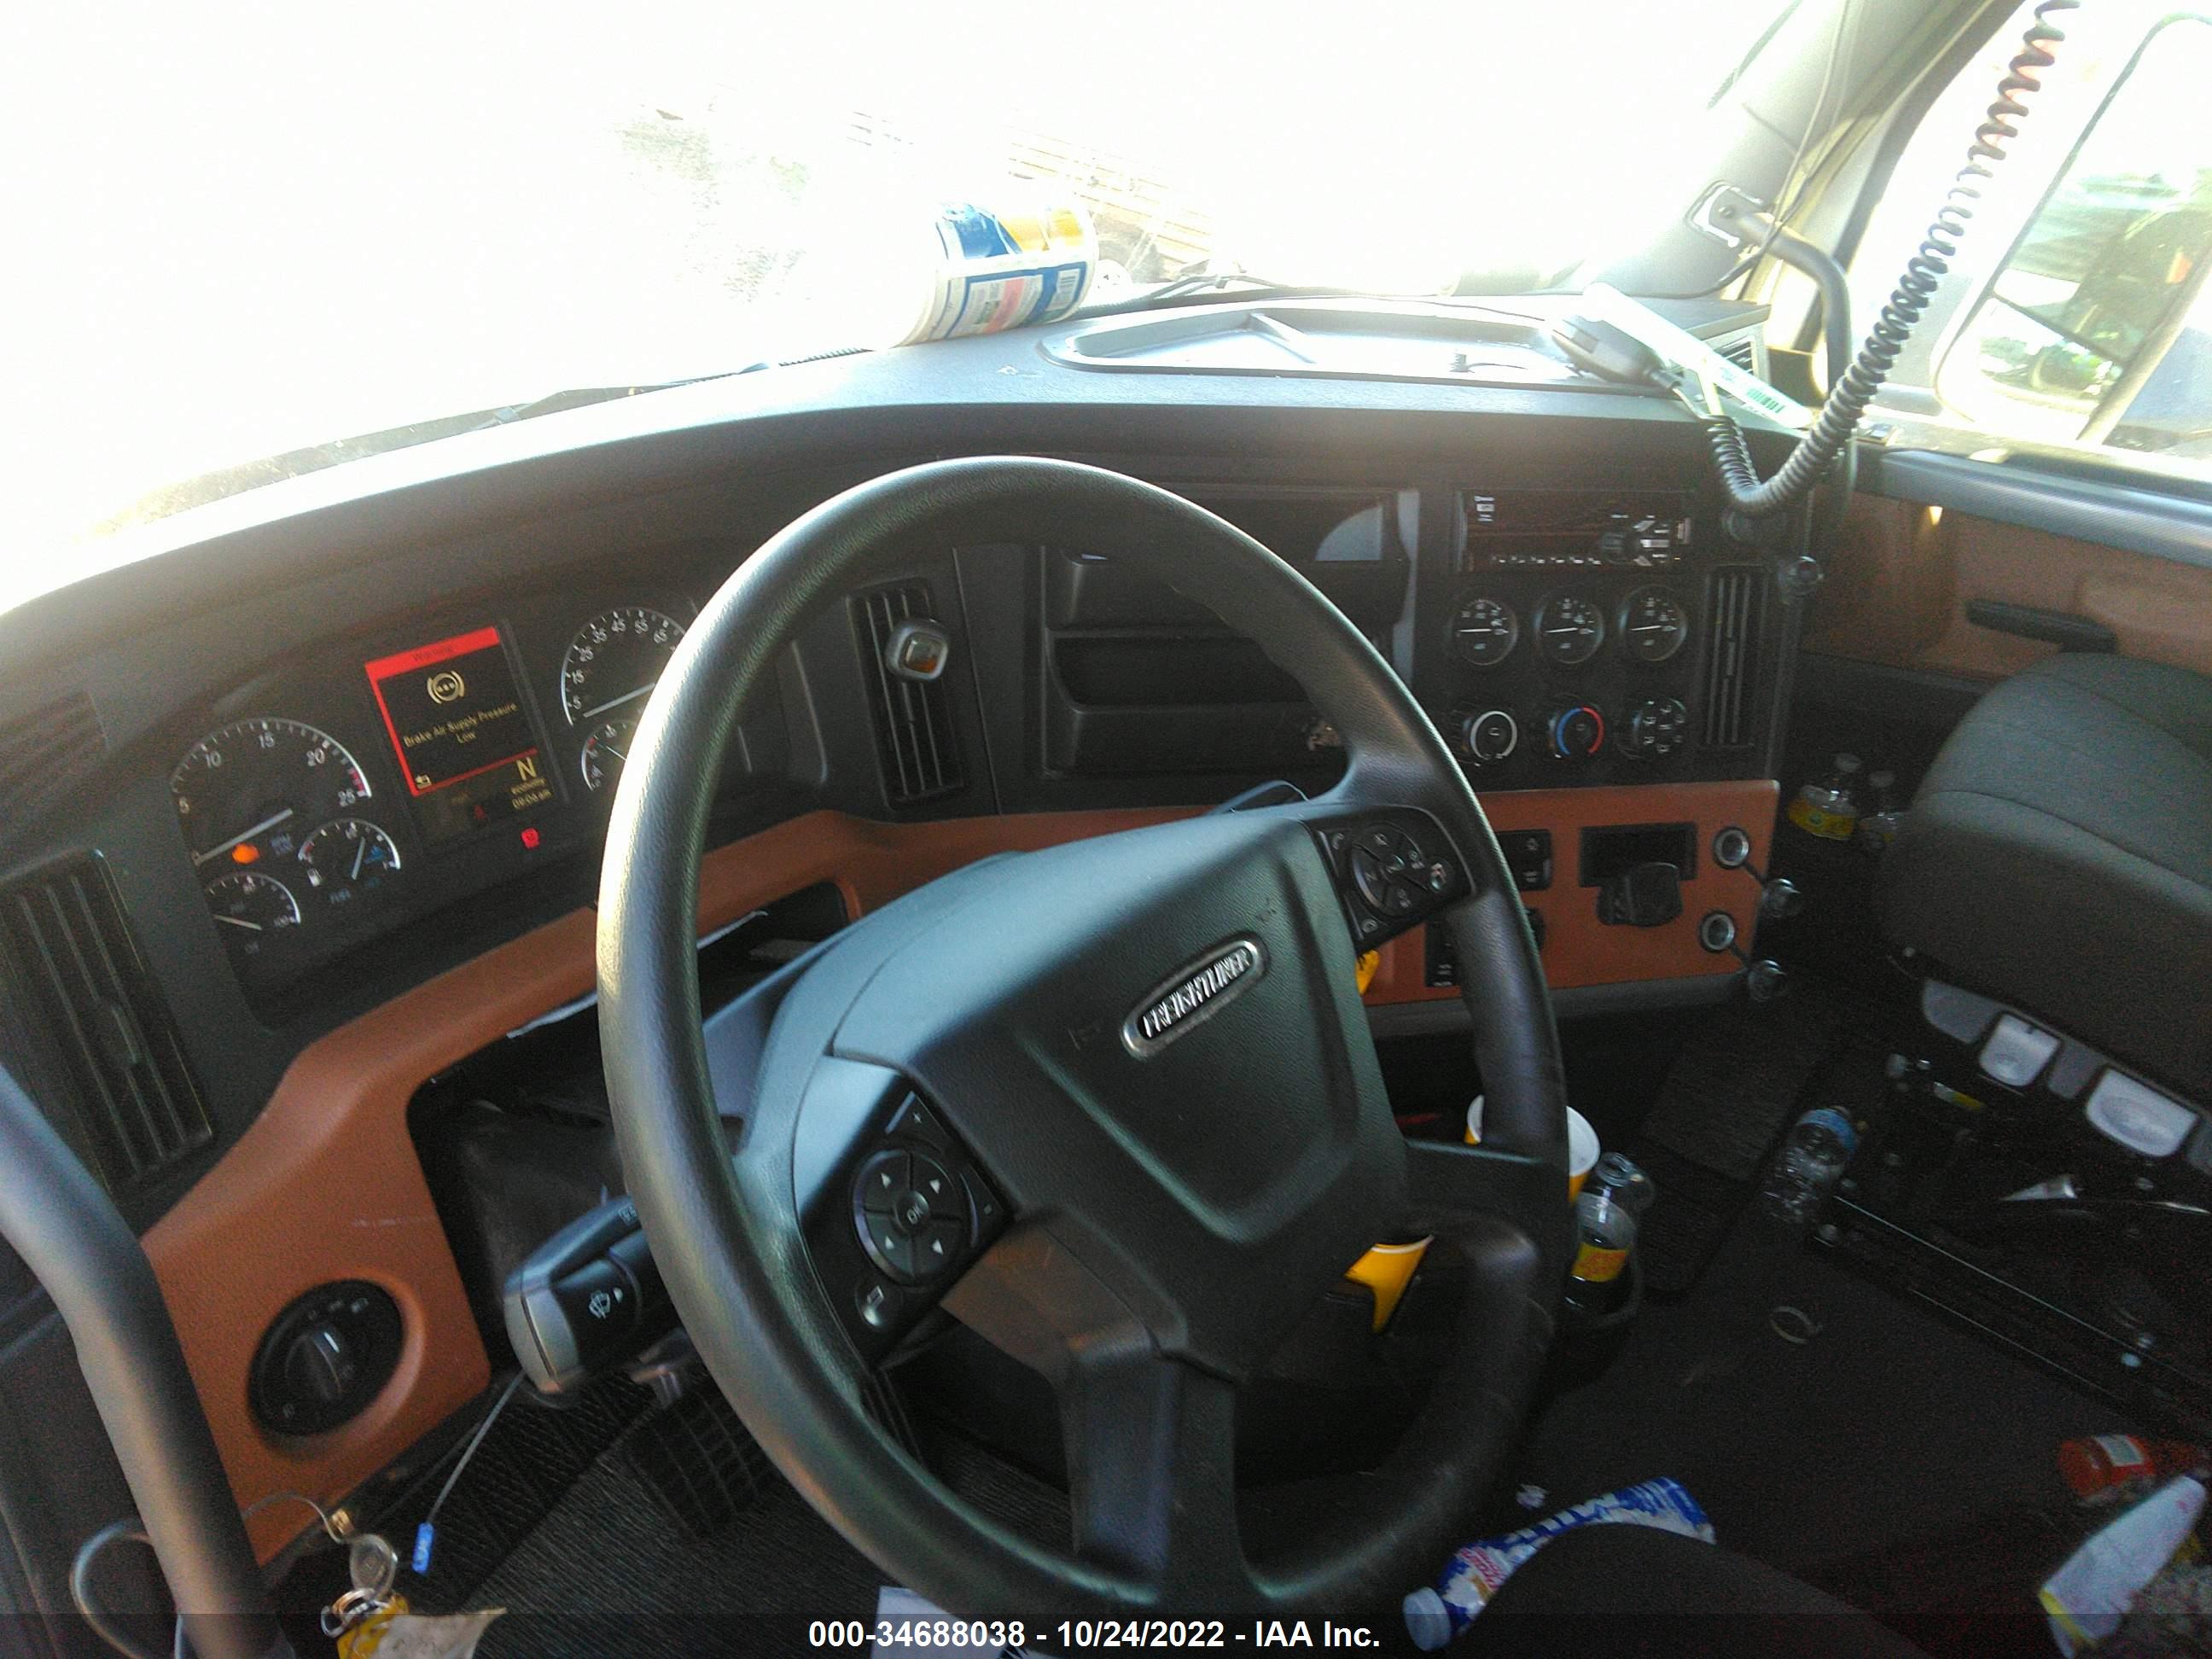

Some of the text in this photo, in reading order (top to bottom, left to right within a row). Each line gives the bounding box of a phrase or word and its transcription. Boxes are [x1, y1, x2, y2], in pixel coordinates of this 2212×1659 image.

[403, 703, 518, 748] Brake Air Supply Pressure
[259, 731, 276, 749] 15
[457, 730, 477, 745] Low
[204, 750, 222, 769] 10
[306, 747, 326, 767] 20
[516, 756, 538, 781] N
[178, 795, 190, 814] 5
[337, 788, 356, 808] 25
[905, 1202, 924, 1225] OK
